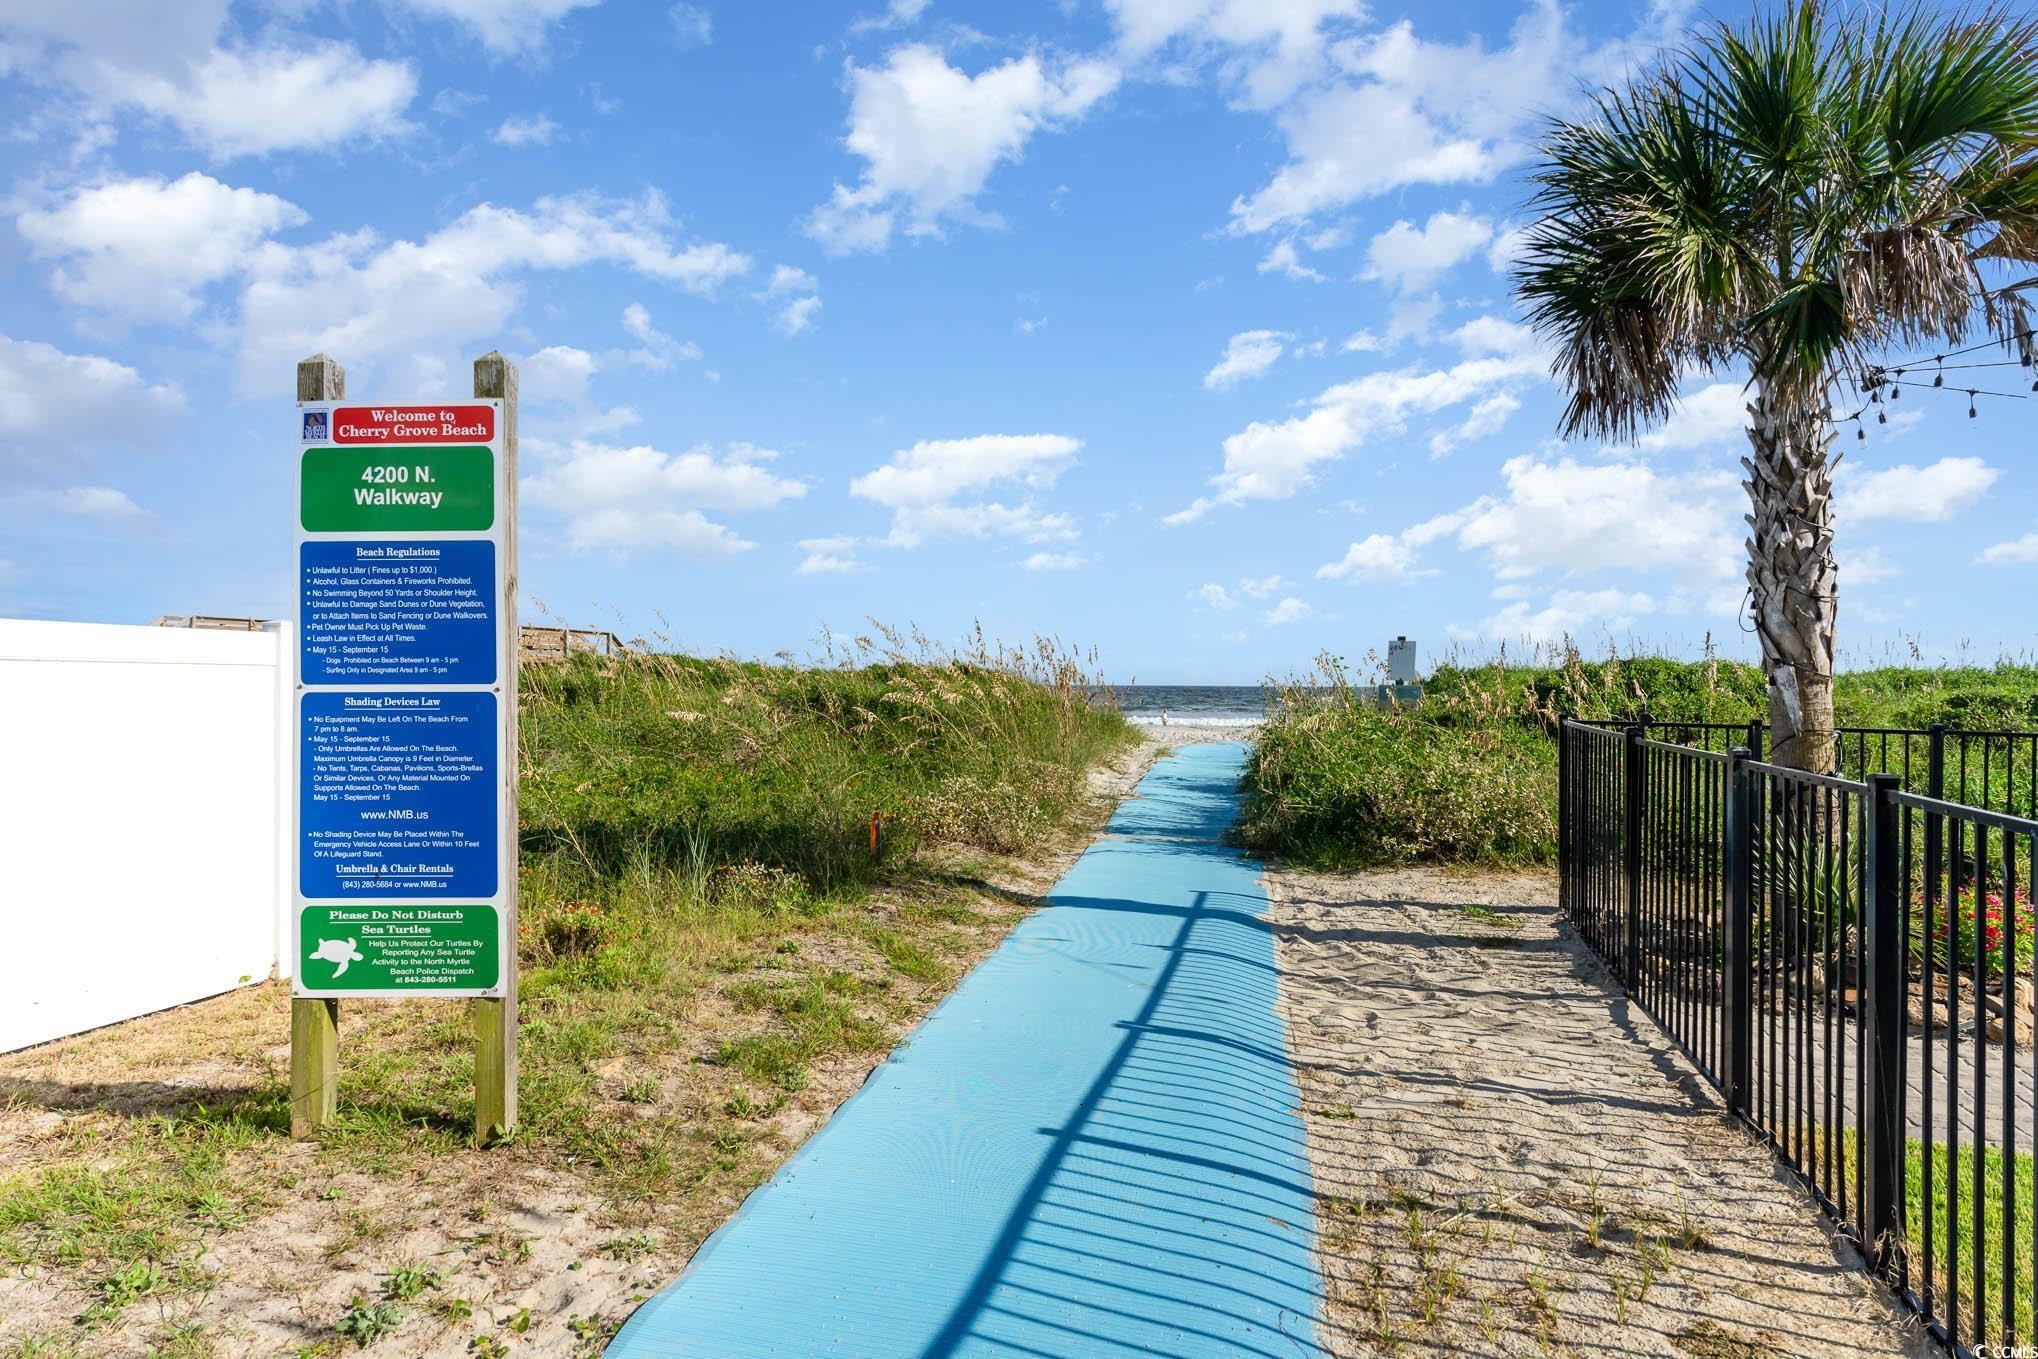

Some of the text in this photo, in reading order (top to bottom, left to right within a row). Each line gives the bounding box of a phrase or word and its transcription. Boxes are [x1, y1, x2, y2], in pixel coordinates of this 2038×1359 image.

[371, 410, 455, 423] Welcome to
[338, 424, 390, 438] Cherry
[393, 424, 438, 436] Grove
[441, 424, 487, 436] Beach
[361, 467, 435, 484] 4200 N.
[354, 488, 443, 510] Walkway
[356, 548, 441, 558] Beach Regulations
[323, 589, 357, 598] Swimming
[359, 589, 384, 598] Beyond
[350, 601, 378, 609] Damage
[398, 612, 424, 621] Fencing
[381, 624, 390, 632] Up
[313, 647, 327, 655] May
[343, 647, 379, 655] September
[344, 697, 441, 708] Shading Devices Law
[325, 716, 360, 724] Equipment
[362, 716, 376, 724] May
[314, 736, 328, 744] May
[344, 736, 380, 744] September
[361, 810, 429, 820] www.NMB.us
[314, 841, 351, 849] Emergency
[336, 864, 454, 874] Umbrella & Chair Rentals
[342, 881, 360, 890] (843)
[329, 911, 463, 920] Please Do Not Disturb
[361, 926, 431, 934] Sea Turtles
[369, 940, 387, 949] Help
[473, 940, 484, 949] By
